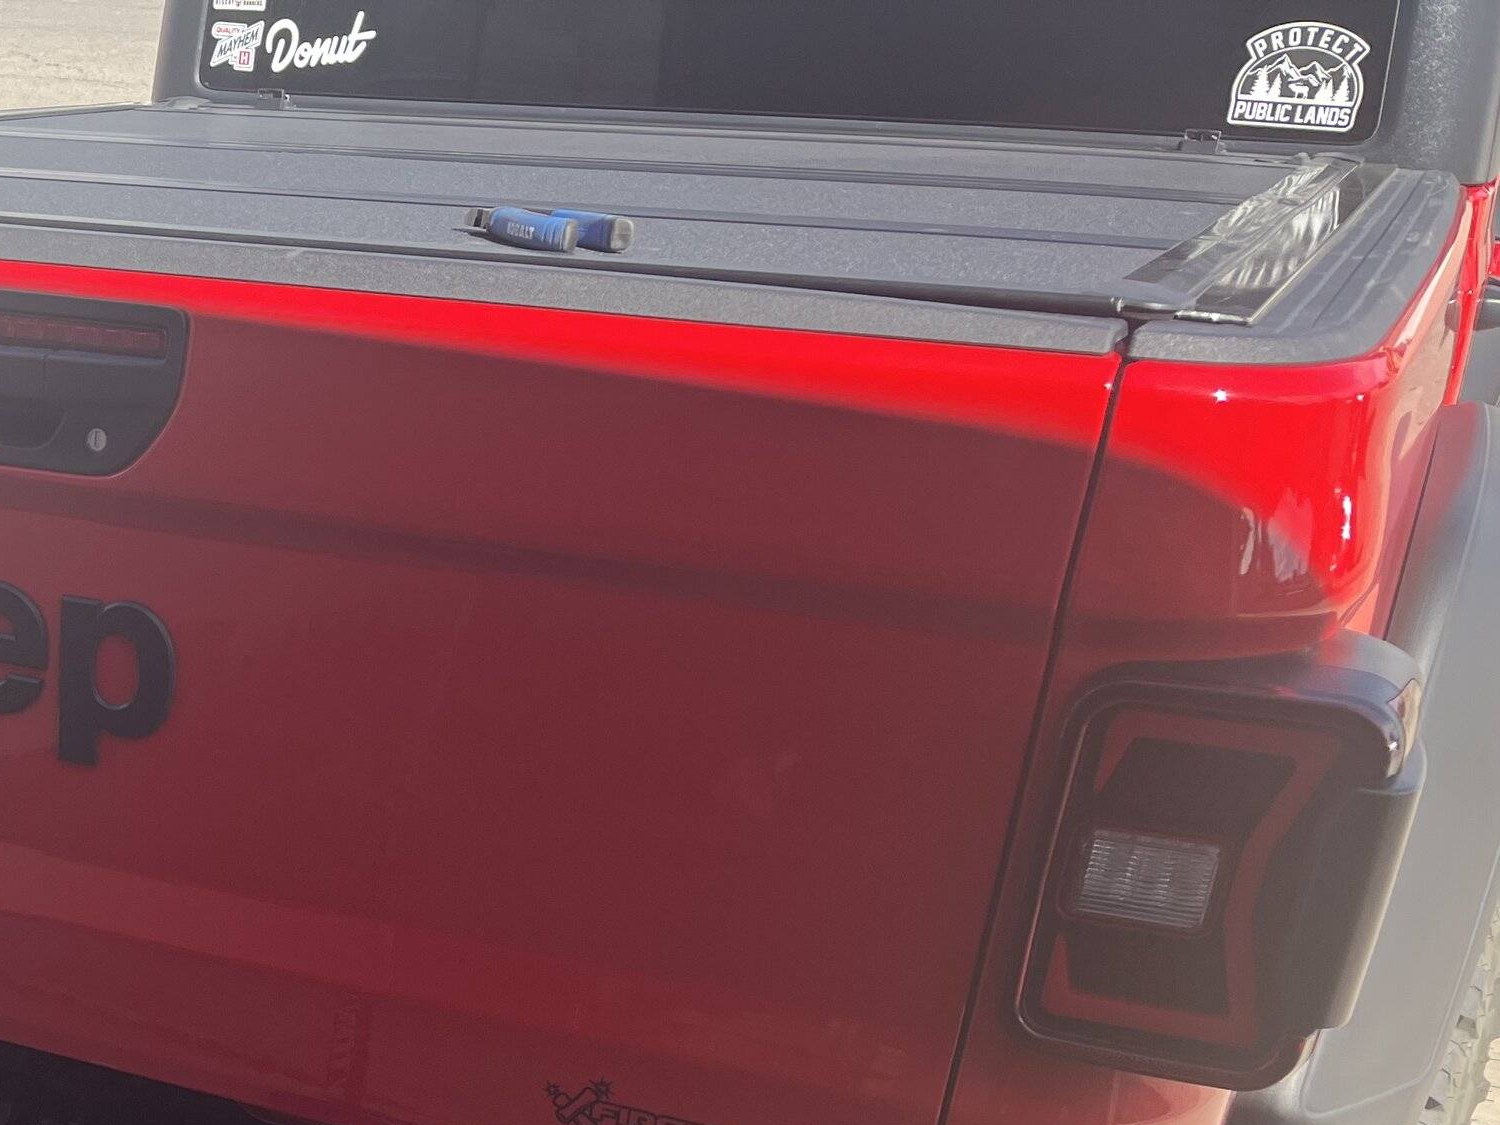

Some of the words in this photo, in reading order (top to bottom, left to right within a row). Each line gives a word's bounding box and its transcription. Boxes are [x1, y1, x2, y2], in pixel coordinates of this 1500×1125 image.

[217, 28, 260, 58] MAYHEM
[266, 11, 376, 72] Donut
[1254, 27, 1364, 62] PROTECT
[1233, 100, 1292, 123] PUBLIC
[1294, 105, 1352, 127] LANDS
